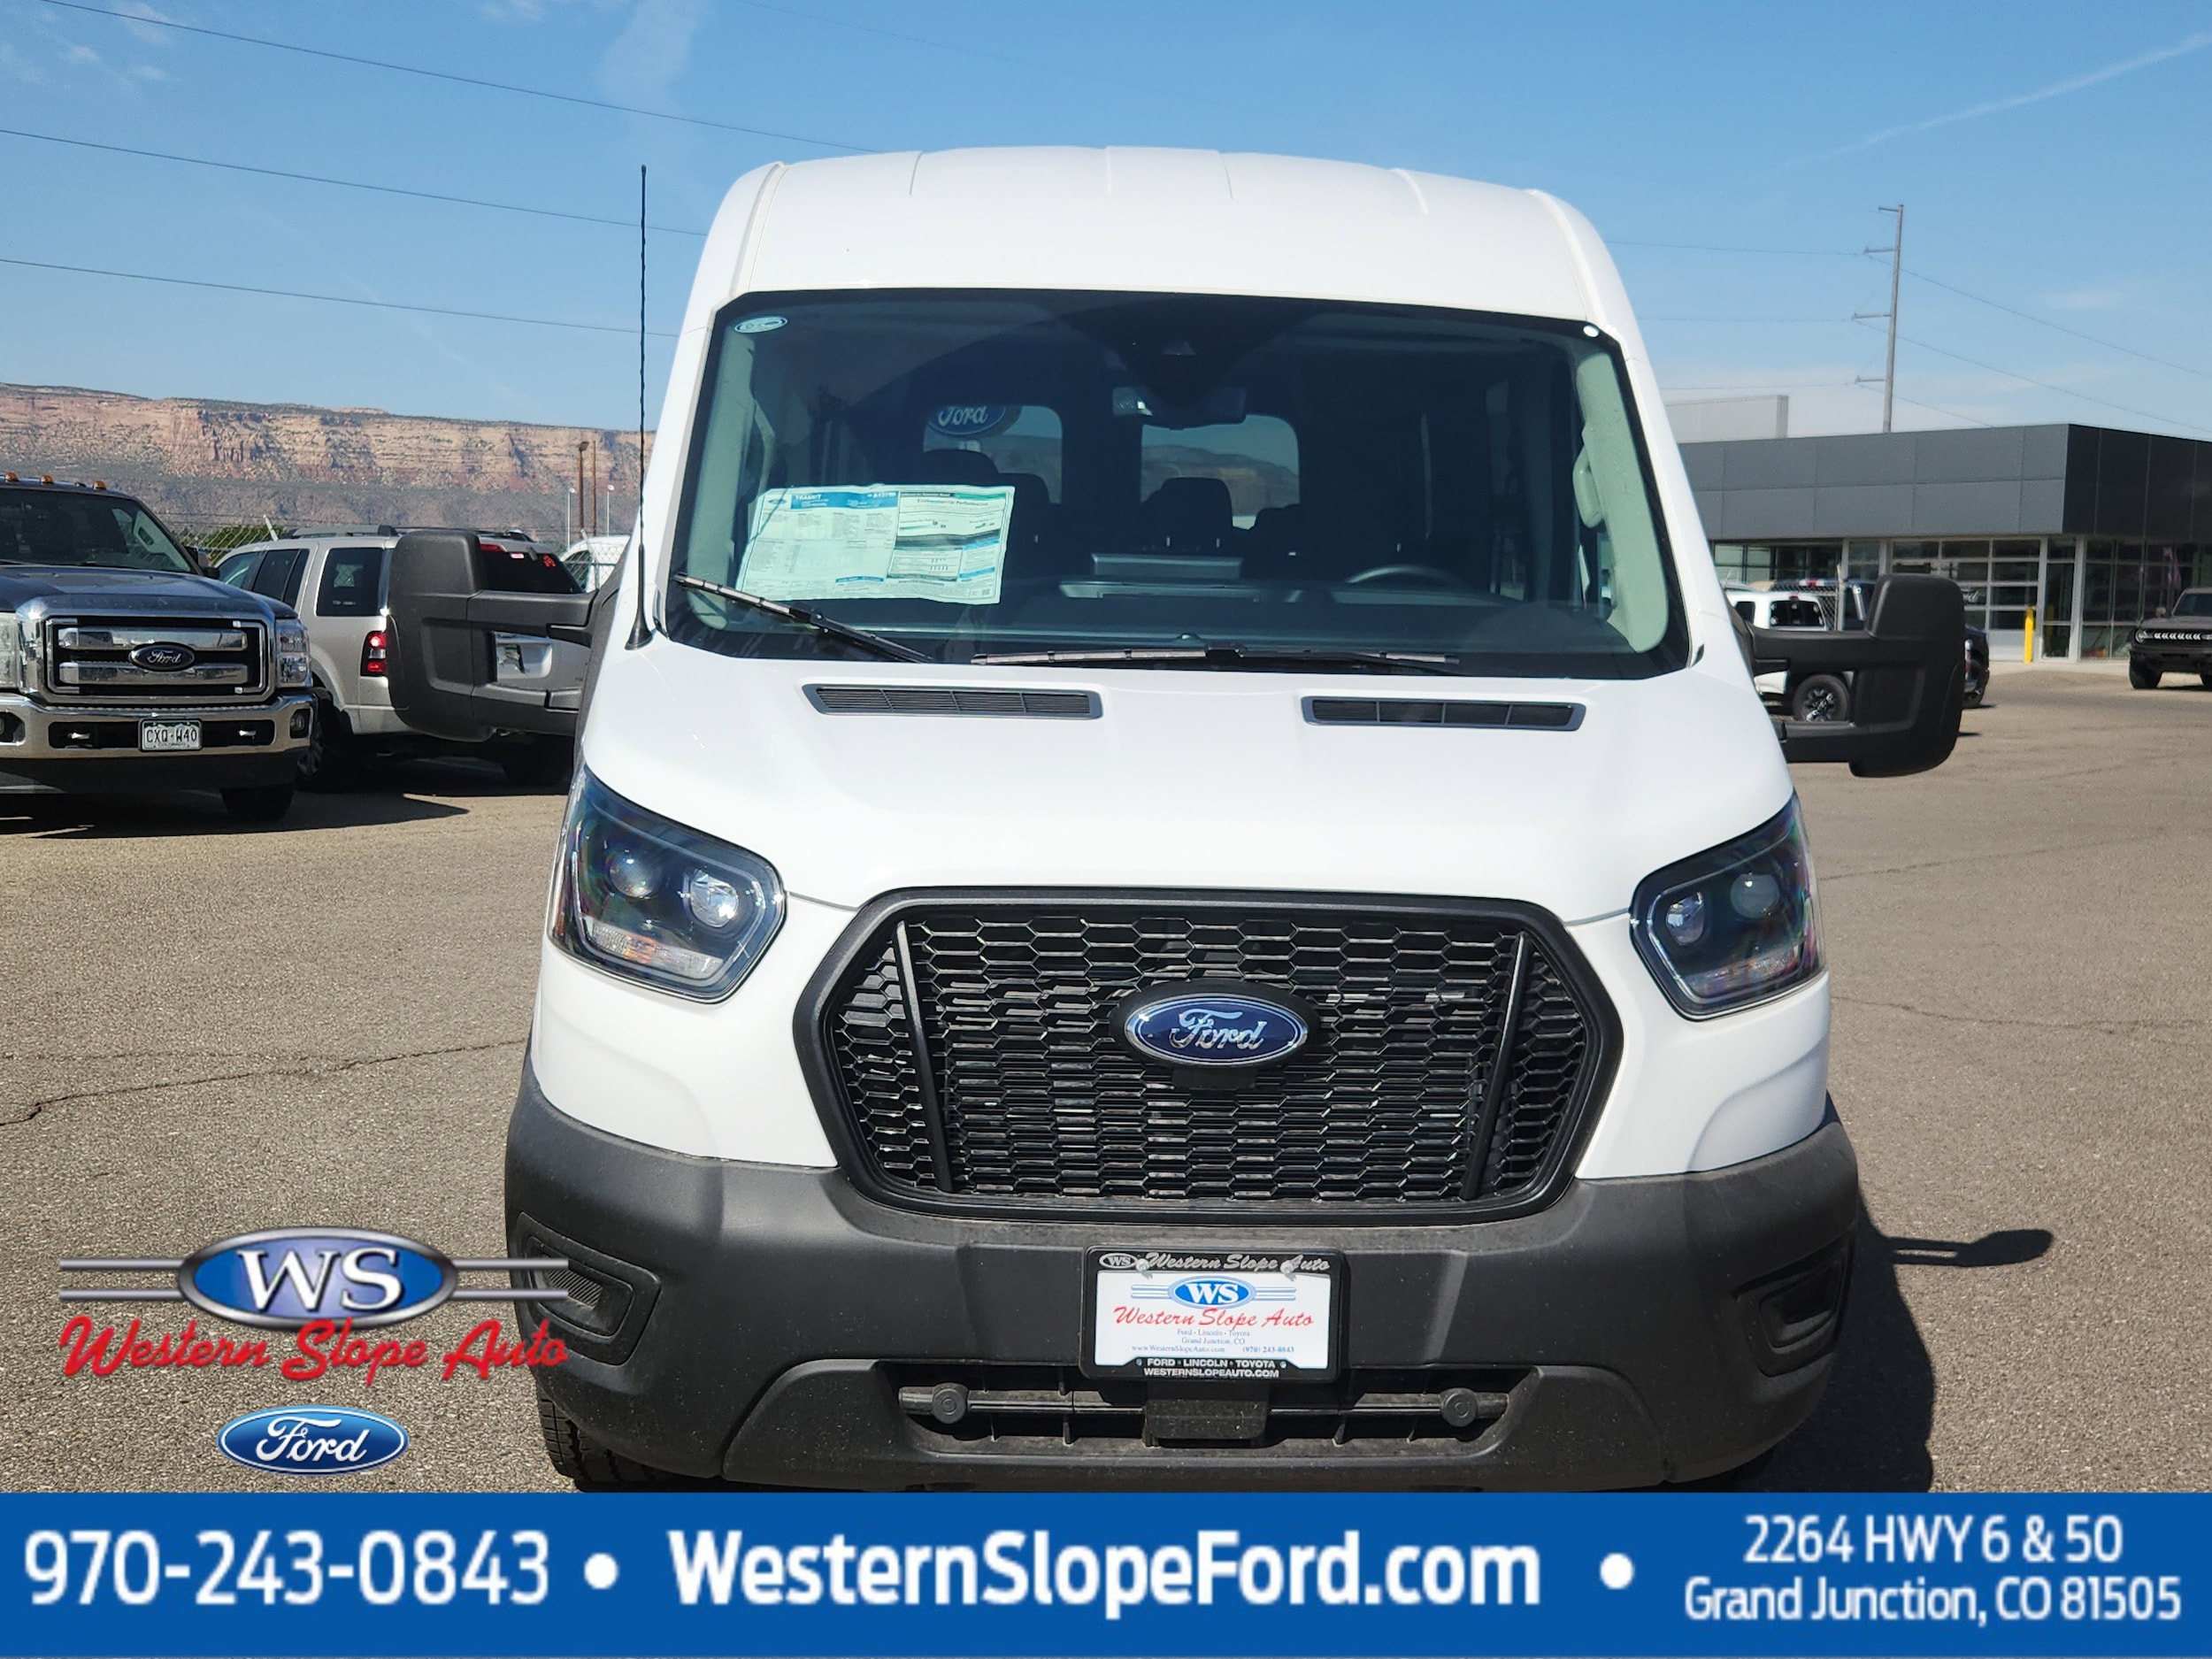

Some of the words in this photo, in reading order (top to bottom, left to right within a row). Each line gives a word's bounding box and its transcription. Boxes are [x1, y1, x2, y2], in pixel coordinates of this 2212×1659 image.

[147, 649, 182, 664] Ford
[1169, 1008, 1268, 1049] Ford
[1107, 1256, 1132, 1267] WS
[1145, 1252, 1221, 1269] Western
[1223, 1253, 1278, 1272] Slope
[1186, 1282, 1240, 1305] WS
[1113, 1305, 1195, 1325] Western
[1198, 1307, 1257, 1332] Slope
[1261, 1307, 1315, 1327] Auto
[1229, 1330, 1251, 1339] Toyota
[1147, 1357, 1175, 1367] FORD
[1183, 1358, 1229, 1368] LINCOLN
[1235, 1360, 1277, 1369] TOYOTA
[1143, 1367, 1280, 1379] WESTERNSLOPEAUTO.COM
